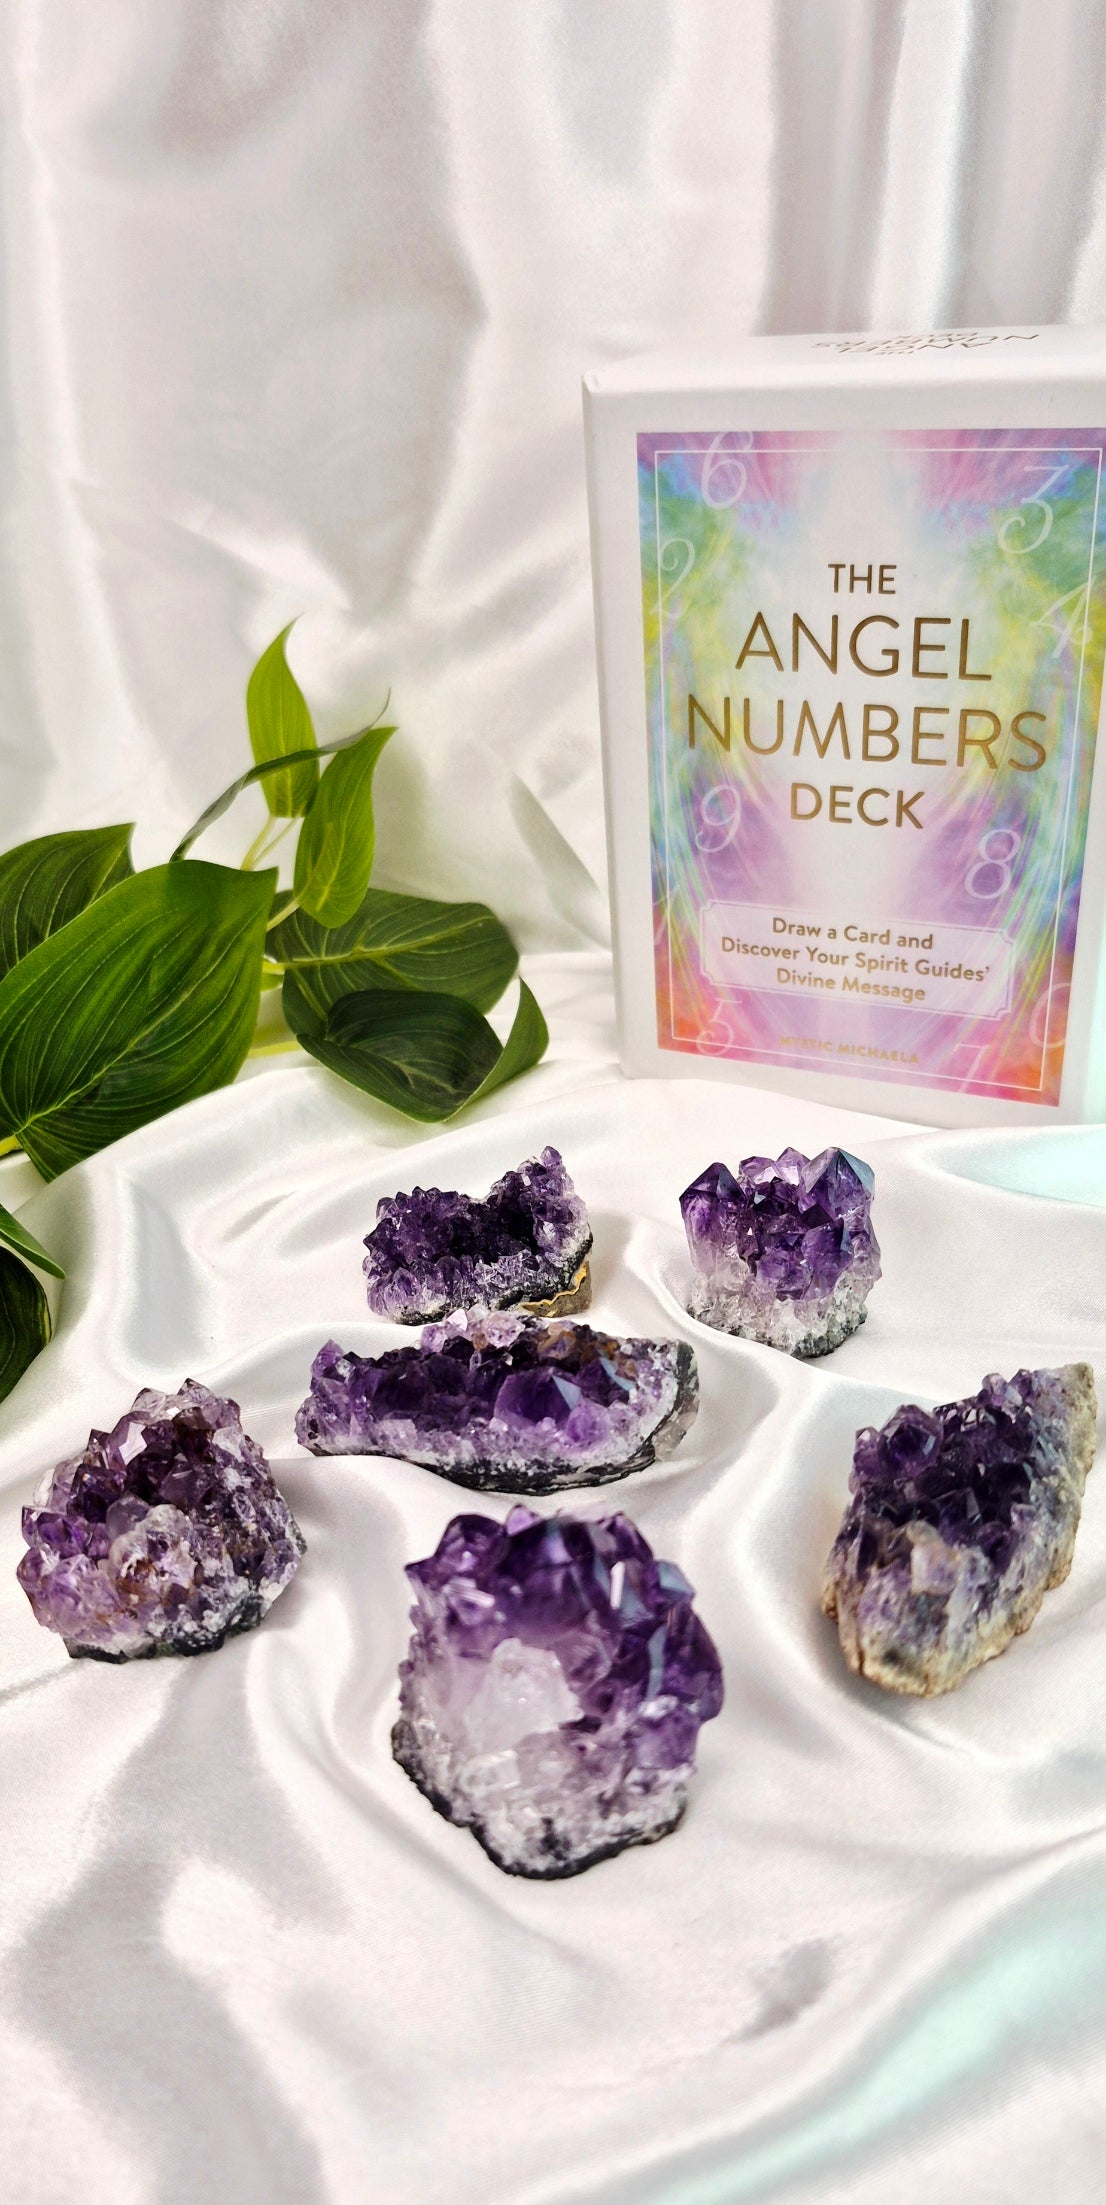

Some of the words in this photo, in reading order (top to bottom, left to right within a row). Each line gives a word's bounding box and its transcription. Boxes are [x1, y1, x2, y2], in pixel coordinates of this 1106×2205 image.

[997, 464, 1070, 554] 3
[648, 538, 696, 619] 2
[828, 563, 898, 595] THE
[735, 611, 993, 682] ANGEL
[687, 693, 1048, 772] NUMBERS
[694, 783, 742, 854] 9
[790, 782, 926, 830] DECK
[963, 828, 1022, 900] 8
[721, 936, 800, 961] Discover
[805, 946, 850, 966] Your
[855, 952, 909, 975] Spirit
[772, 917, 822, 938] Draw
[827, 928, 837, 940] a
[843, 925, 891, 946] Card
[896, 933, 934, 950] and
[776, 967, 836, 990] Divine
[841, 976, 926, 1004] Message
[696, 996, 743, 1057] 5
[779, 1035, 834, 1053] MYSTIC
[837, 1043, 920, 1065] MICHAELA
